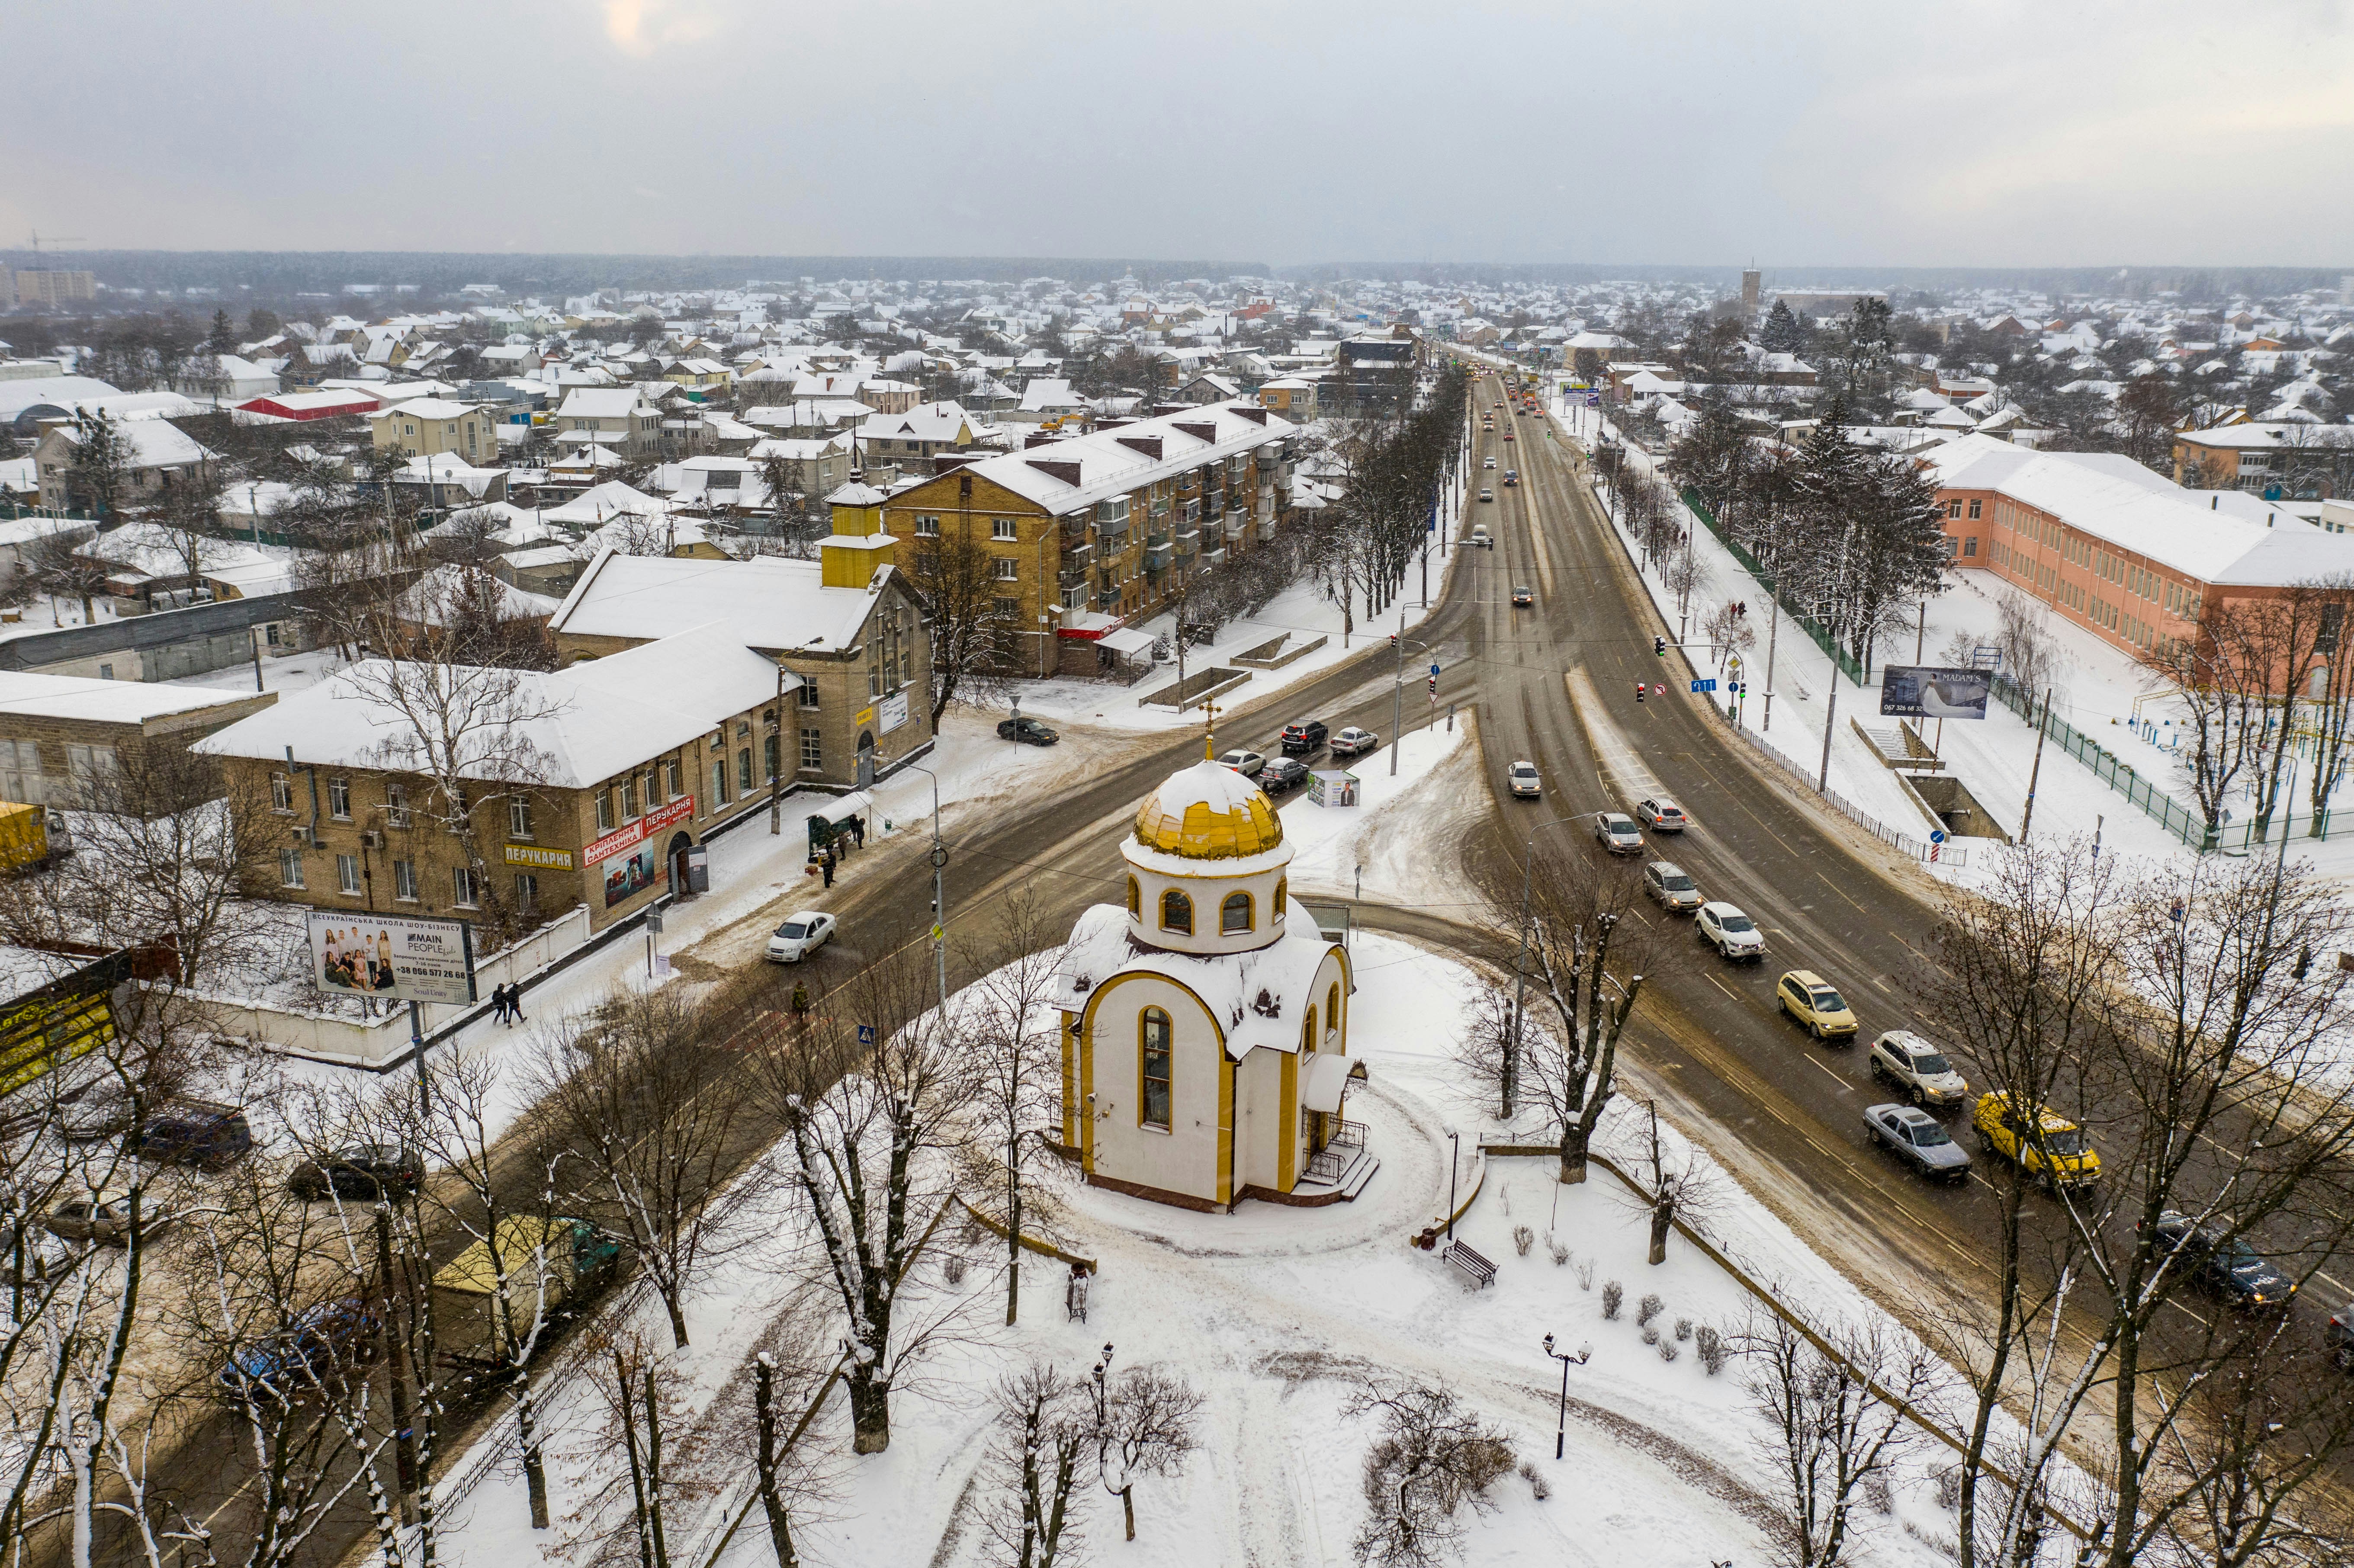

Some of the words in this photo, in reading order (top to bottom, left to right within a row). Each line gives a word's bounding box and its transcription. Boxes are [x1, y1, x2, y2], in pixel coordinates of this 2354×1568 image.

[1942, 674, 1981, 682] MADAM'S
[646, 798, 691, 827] ПЕРУКАРНЯ
[589, 827, 635, 853] КРІПЛЕННЯ
[588, 834, 638, 863] САНТЕХНІКА
[506, 847, 572, 867] ПЕРУКАРНЯ
[313, 914, 373, 924] ВСЕУКРАЇНСЬКА
[407, 922, 460, 931] ШОУ-БІЗНЕСУ
[417, 934, 442, 944] MAIN
[408, 943, 443, 953] PEOPLE
[412, 967, 427, 975] 066
[430, 989, 447, 998] Unity
